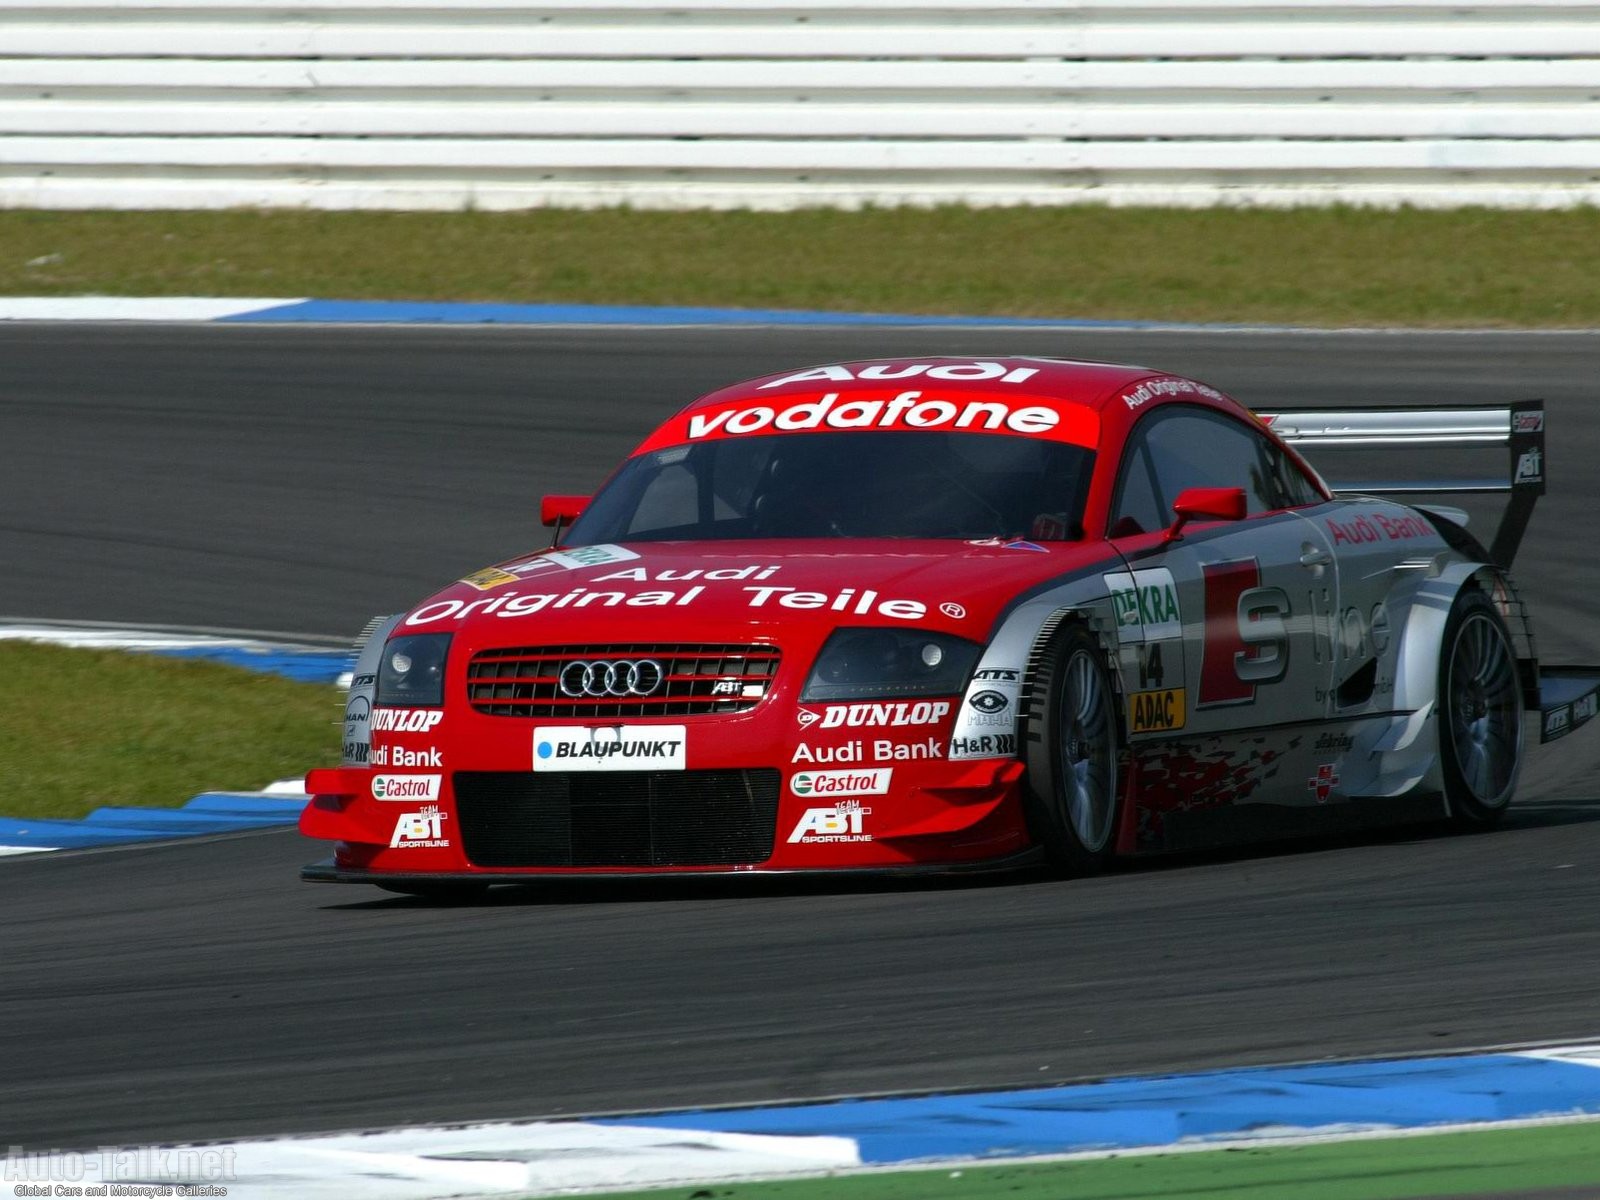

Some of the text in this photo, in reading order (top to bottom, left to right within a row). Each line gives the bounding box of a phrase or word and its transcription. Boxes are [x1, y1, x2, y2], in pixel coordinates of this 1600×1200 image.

[757, 362, 1041, 390] Audi
[1122, 385, 1153, 410] Audi
[688, 391, 1061, 440] vodafone
[1325, 512, 1436, 545] Audi Bank
[591, 565, 782, 583] Audi
[405, 585, 704, 626] Original
[743, 586, 929, 620] Teile
[1111, 583, 1179, 628] DEKRA
[1234, 586, 1292, 684] S
[711, 681, 743, 695] ABT
[973, 670, 1020, 680] ATS
[819, 702, 950, 729] DUNLOP
[1134, 692, 1175, 731] ADAC
[370, 746, 388, 766] udi
[392, 746, 443, 767] Bank
[555, 741, 682, 758] BLAUPUNKT
[791, 737, 942, 764] Audi Bank
[953, 736, 993, 755] H&R
[386, 778, 431, 797] Castrol
[814, 773, 878, 792] Castrol
[389, 812, 442, 848] ABT
[786, 807, 864, 843] ABT
[399, 840, 450, 848] SPORTSLINE
[802, 835, 872, 843] SPORTSLINE
